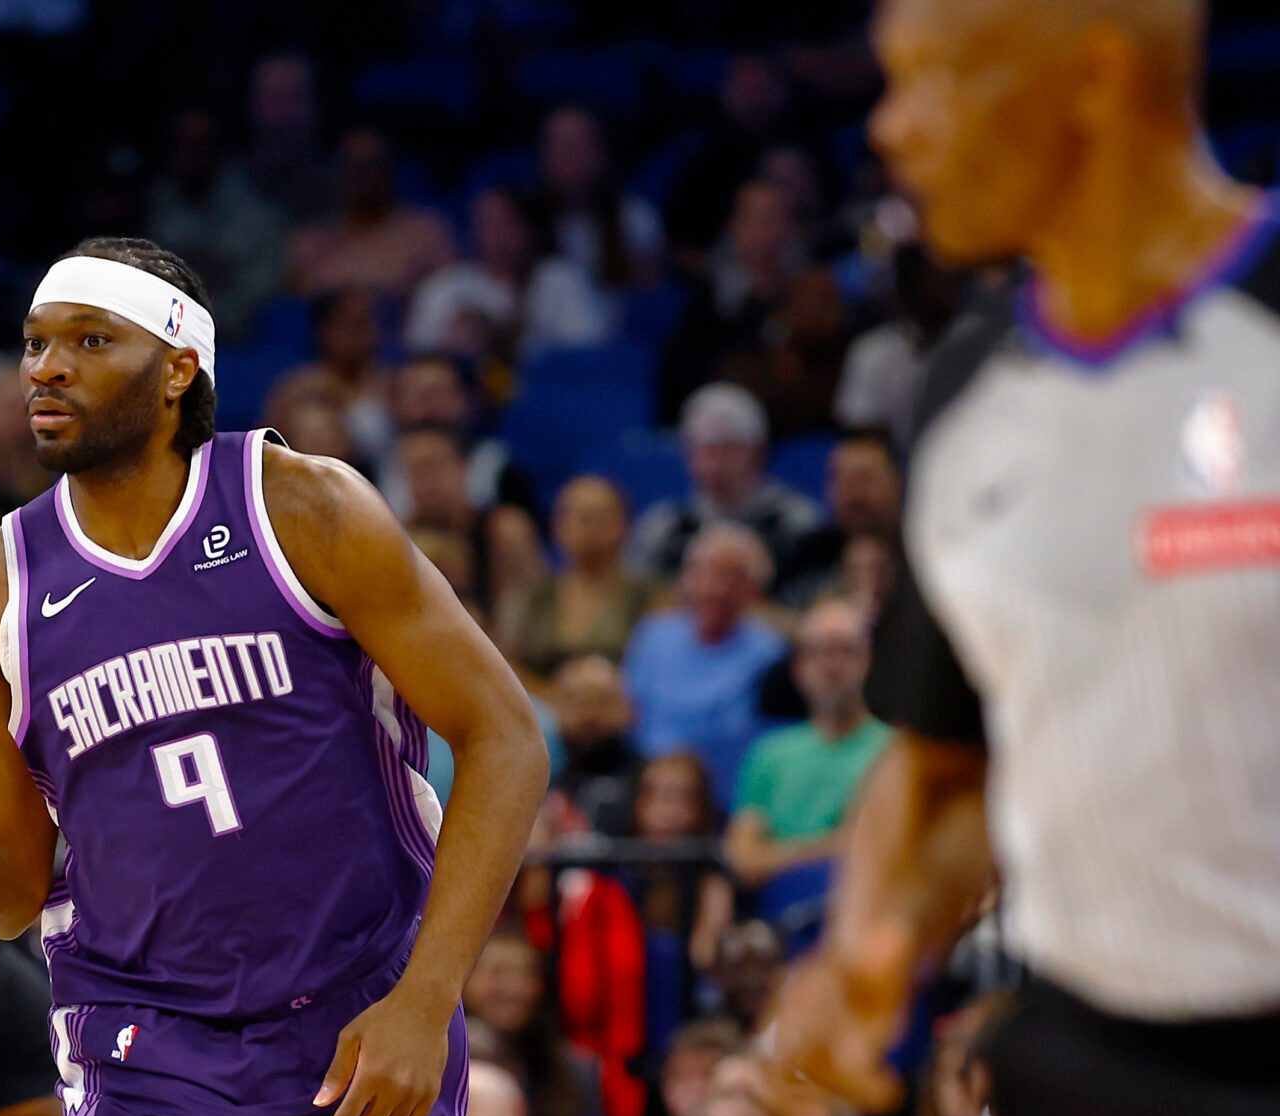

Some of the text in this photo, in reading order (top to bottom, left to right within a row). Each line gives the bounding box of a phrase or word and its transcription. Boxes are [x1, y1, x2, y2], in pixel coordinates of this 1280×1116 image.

[194, 548, 248, 572] PHOONG LAW
[48, 631, 293, 760] SACRAMENTO
[150, 731, 243, 837] 9
